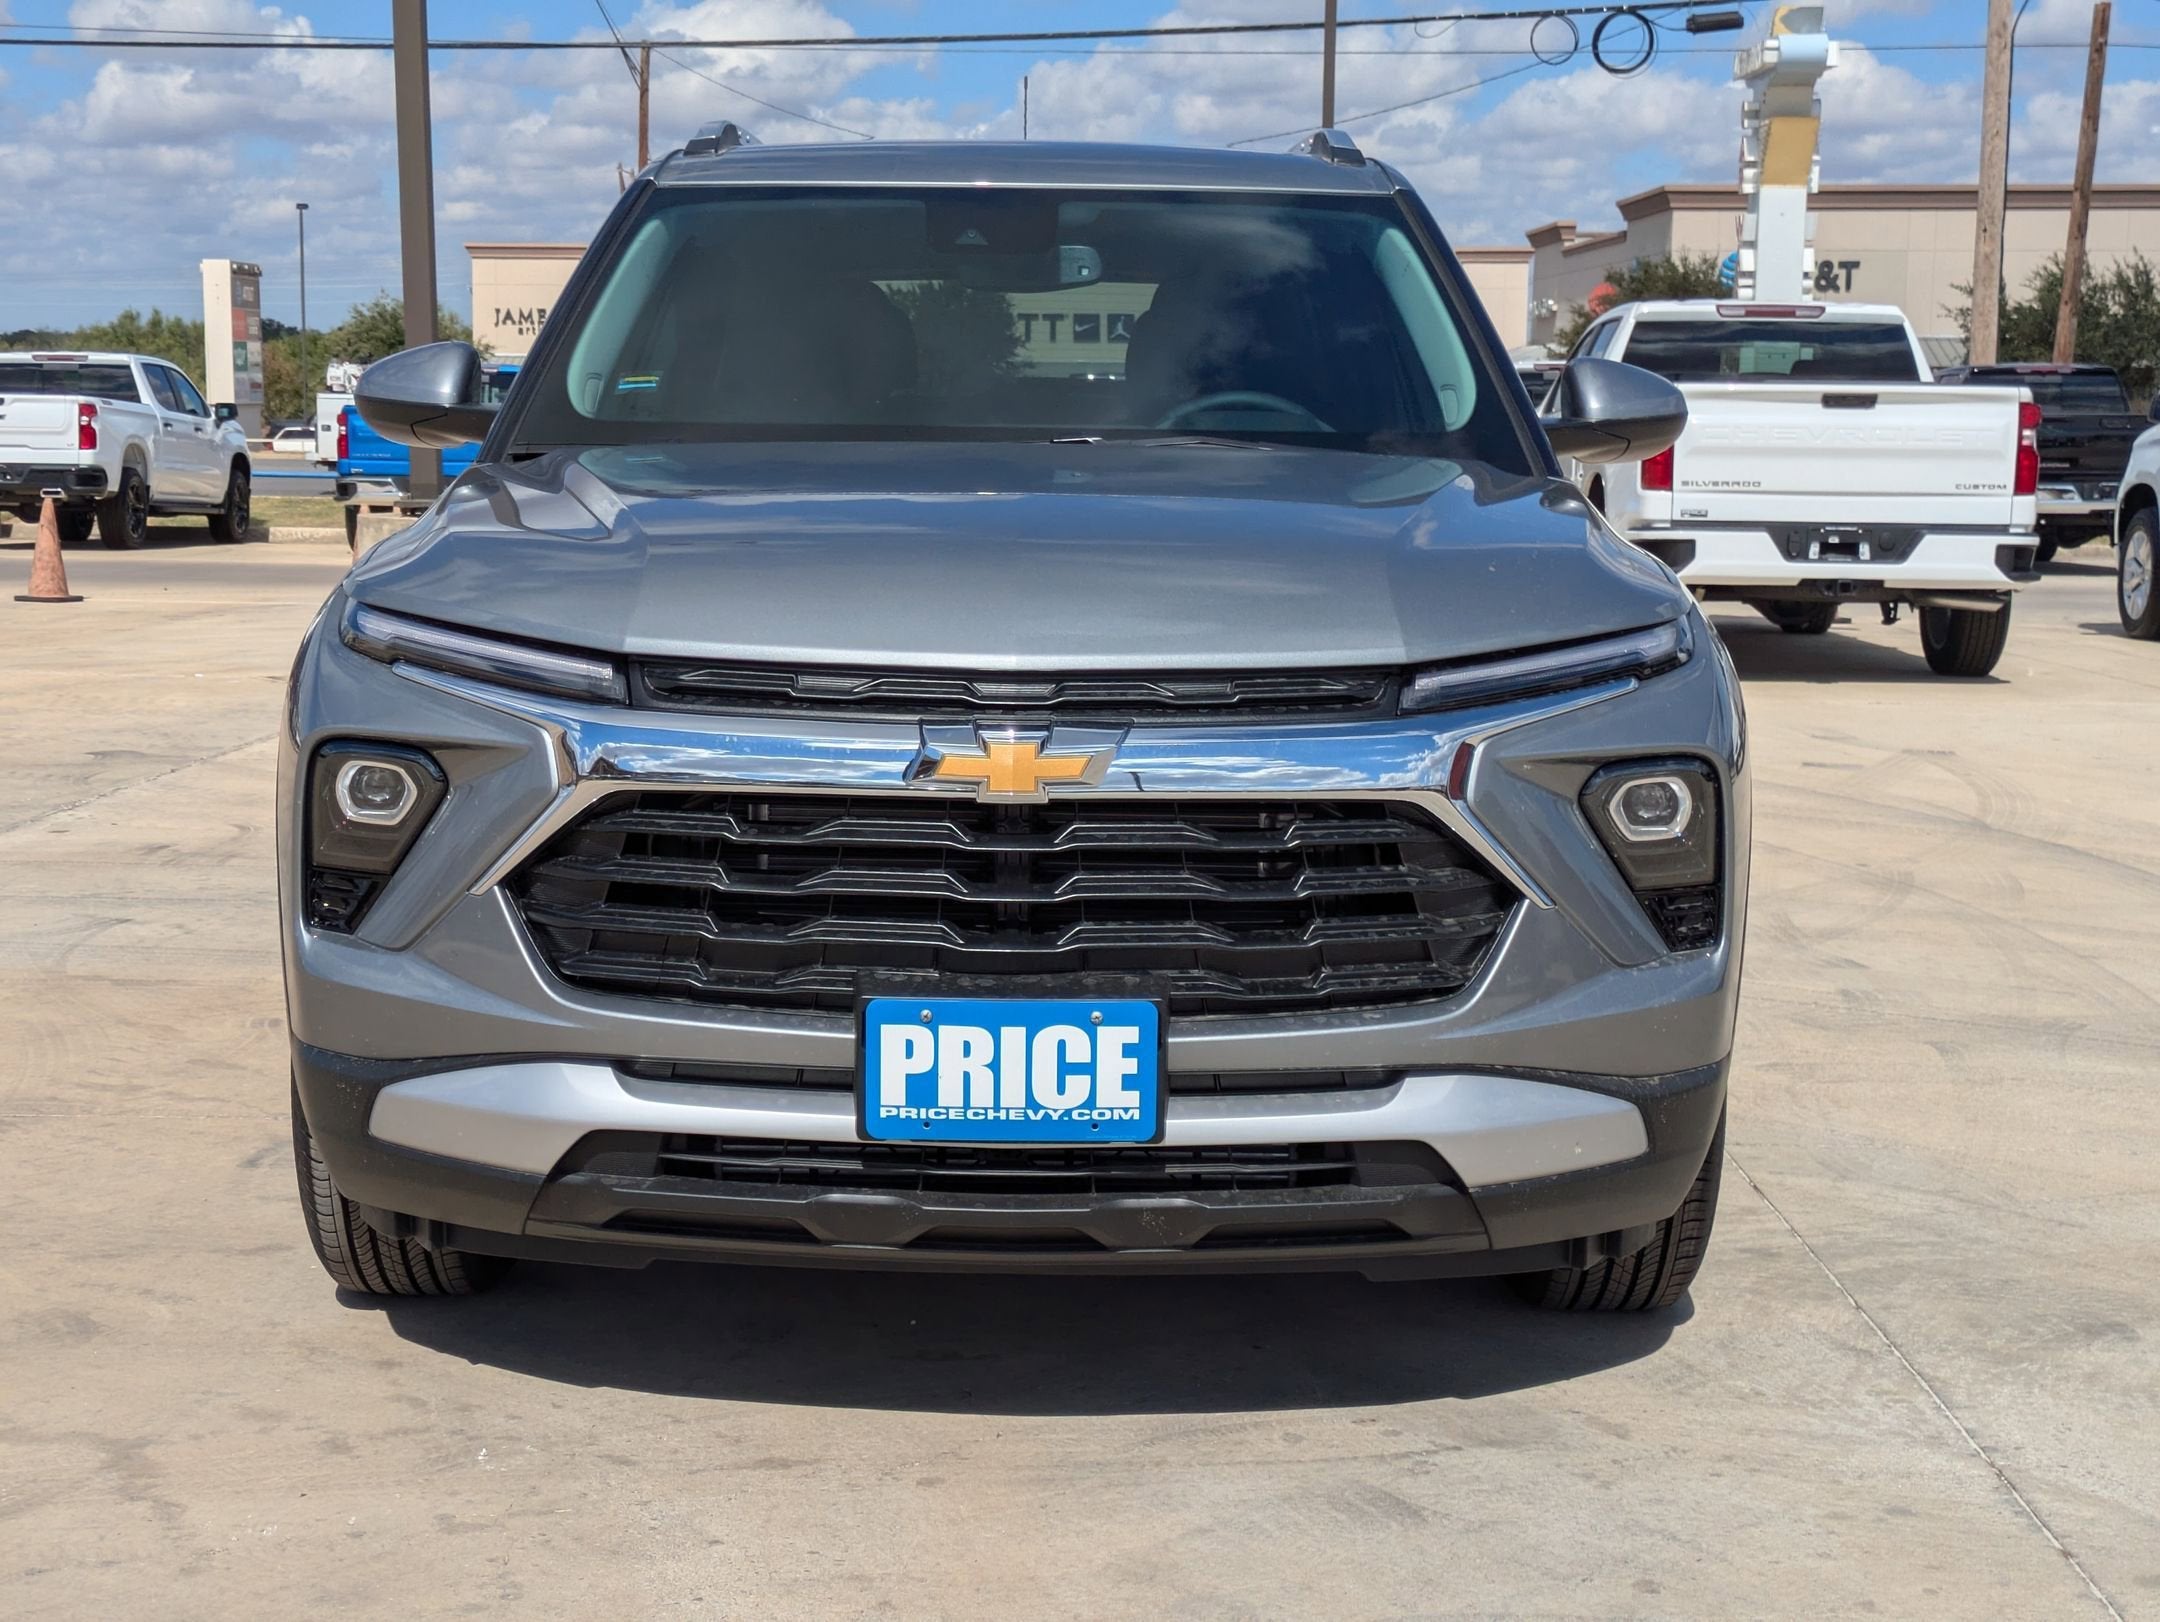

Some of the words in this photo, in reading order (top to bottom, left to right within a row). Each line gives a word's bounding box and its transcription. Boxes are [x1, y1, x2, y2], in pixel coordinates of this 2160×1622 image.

[1701, 427, 1996, 444] CHEVROLET
[1680, 480, 1762, 488] SILVERADO
[880, 1024, 1140, 1110] PRICE
[880, 1107, 1140, 1121] PRICECHEVY.COM
